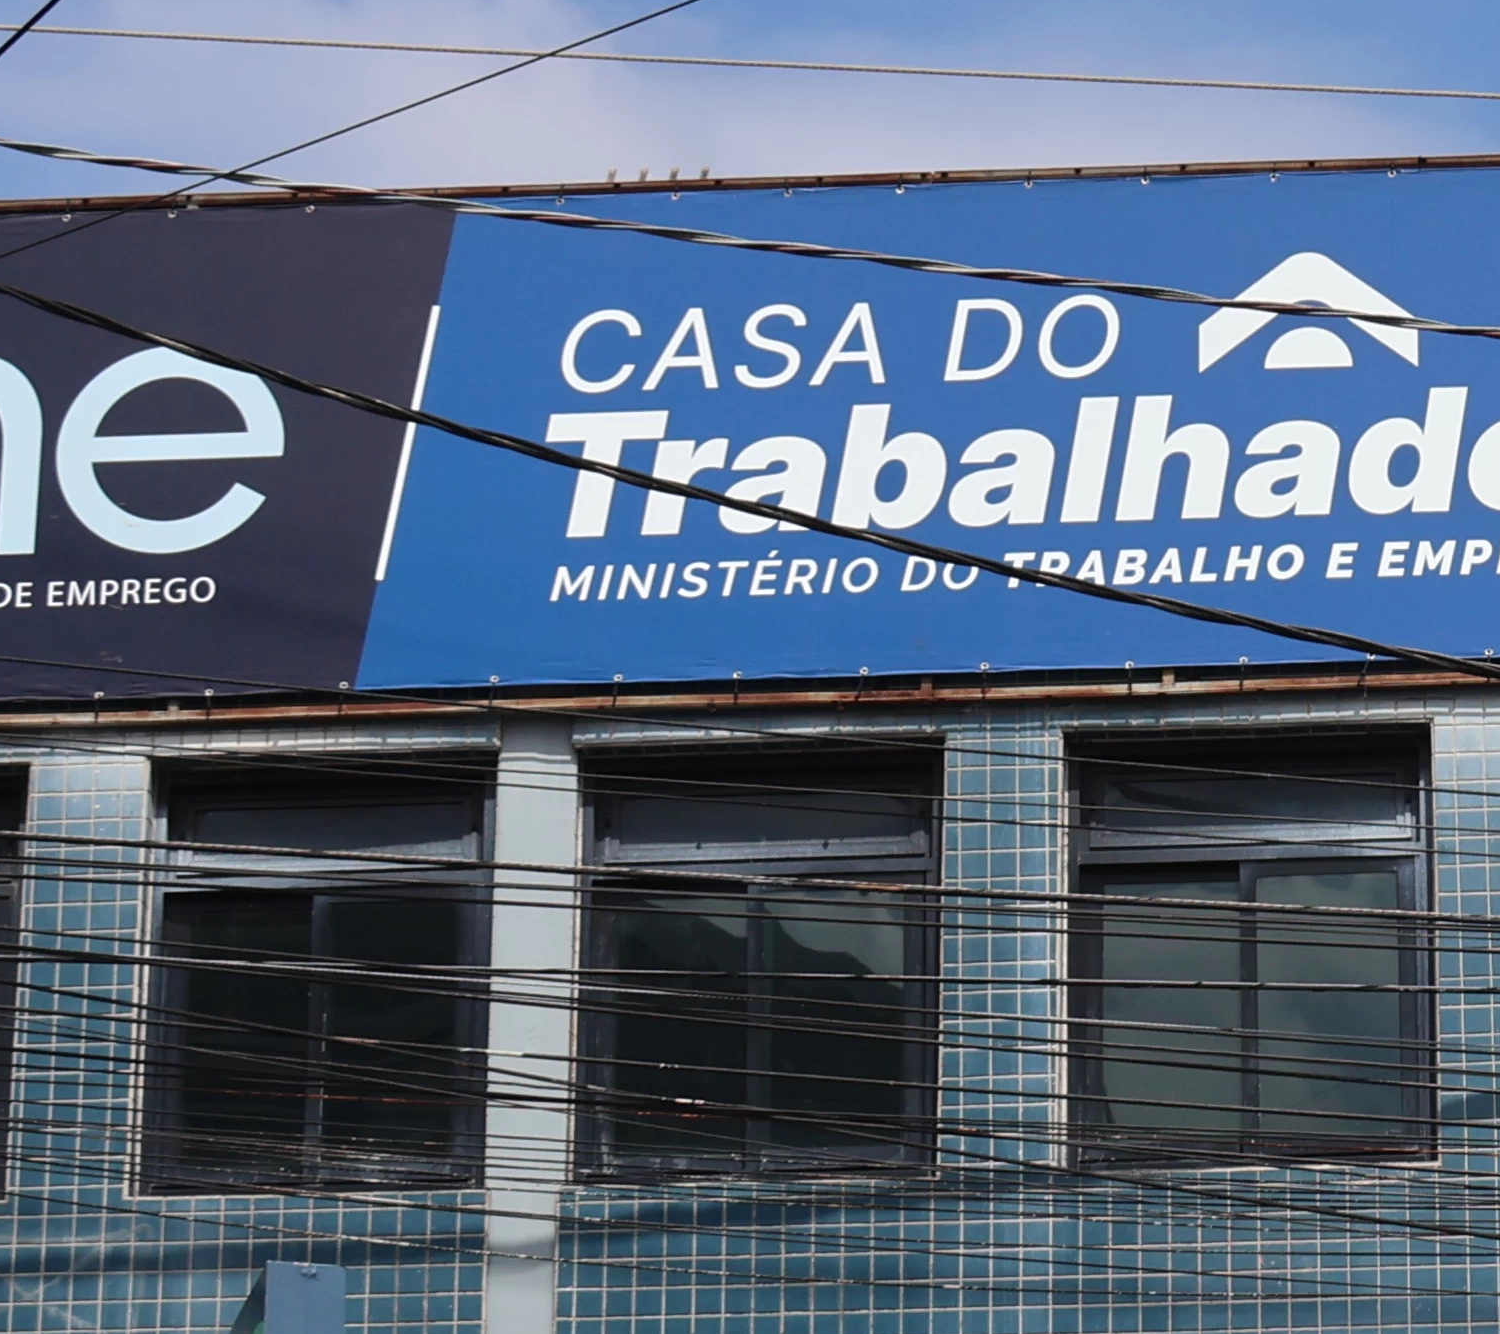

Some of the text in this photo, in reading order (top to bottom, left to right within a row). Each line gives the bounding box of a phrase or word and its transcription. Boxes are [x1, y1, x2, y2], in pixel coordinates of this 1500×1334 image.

[560, 294, 1120, 394] CASA DO
[46, 576, 216, 607] EMPREGO
[549, 551, 880, 602] MINISTÉRIO
[900, 555, 982, 592] DO
[1003, 543, 1305, 589] TRABALHO
[1325, 542, 1359, 579] E
